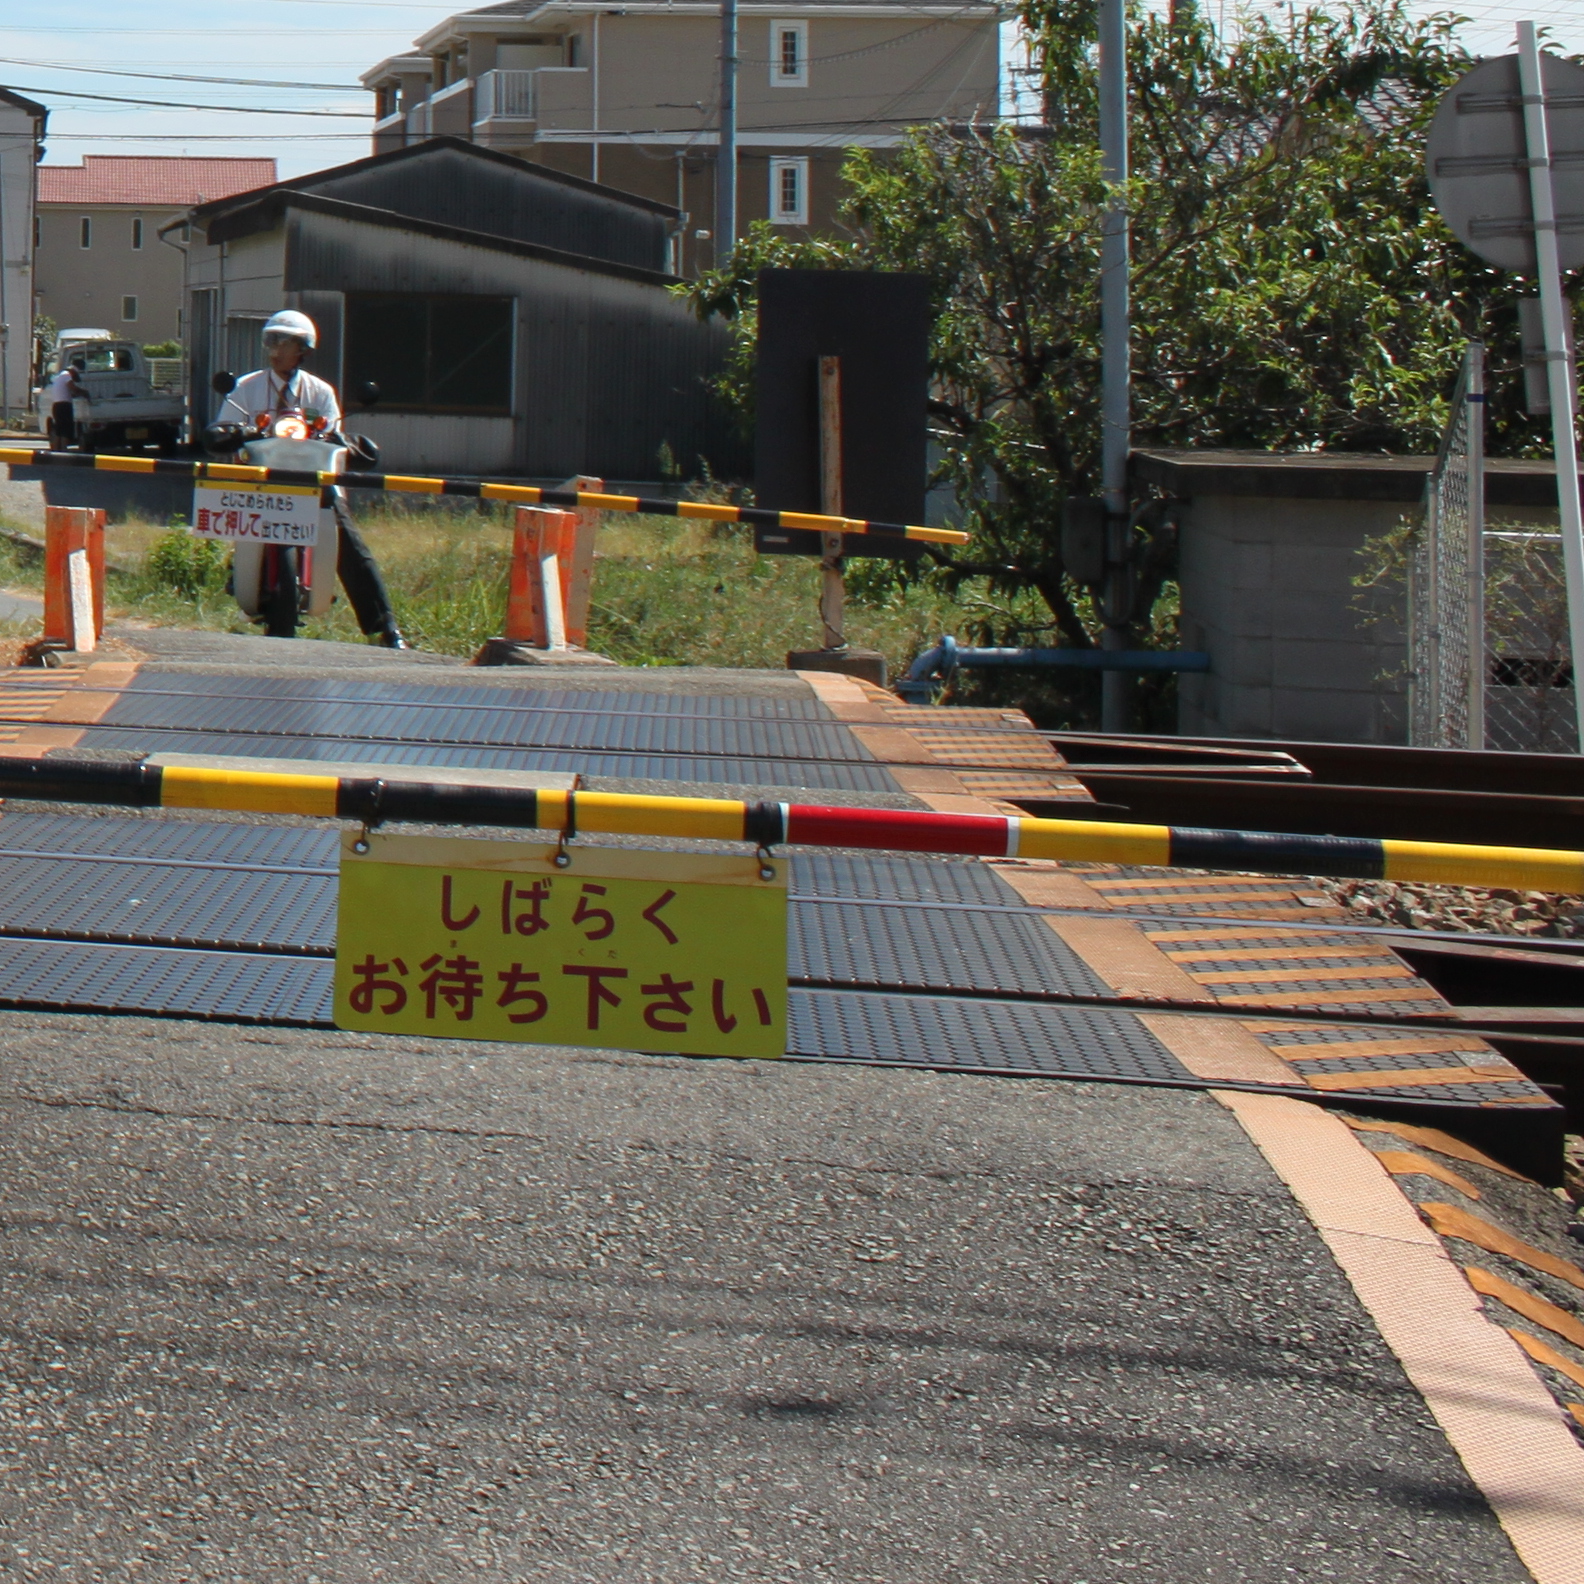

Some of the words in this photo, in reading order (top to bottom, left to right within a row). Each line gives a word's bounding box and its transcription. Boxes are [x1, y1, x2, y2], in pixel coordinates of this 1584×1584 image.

[220, 491, 294, 512] とじこめられたら
[440, 875, 680, 946] しばらく
[348, 953, 773, 1035] お待ち下さい
